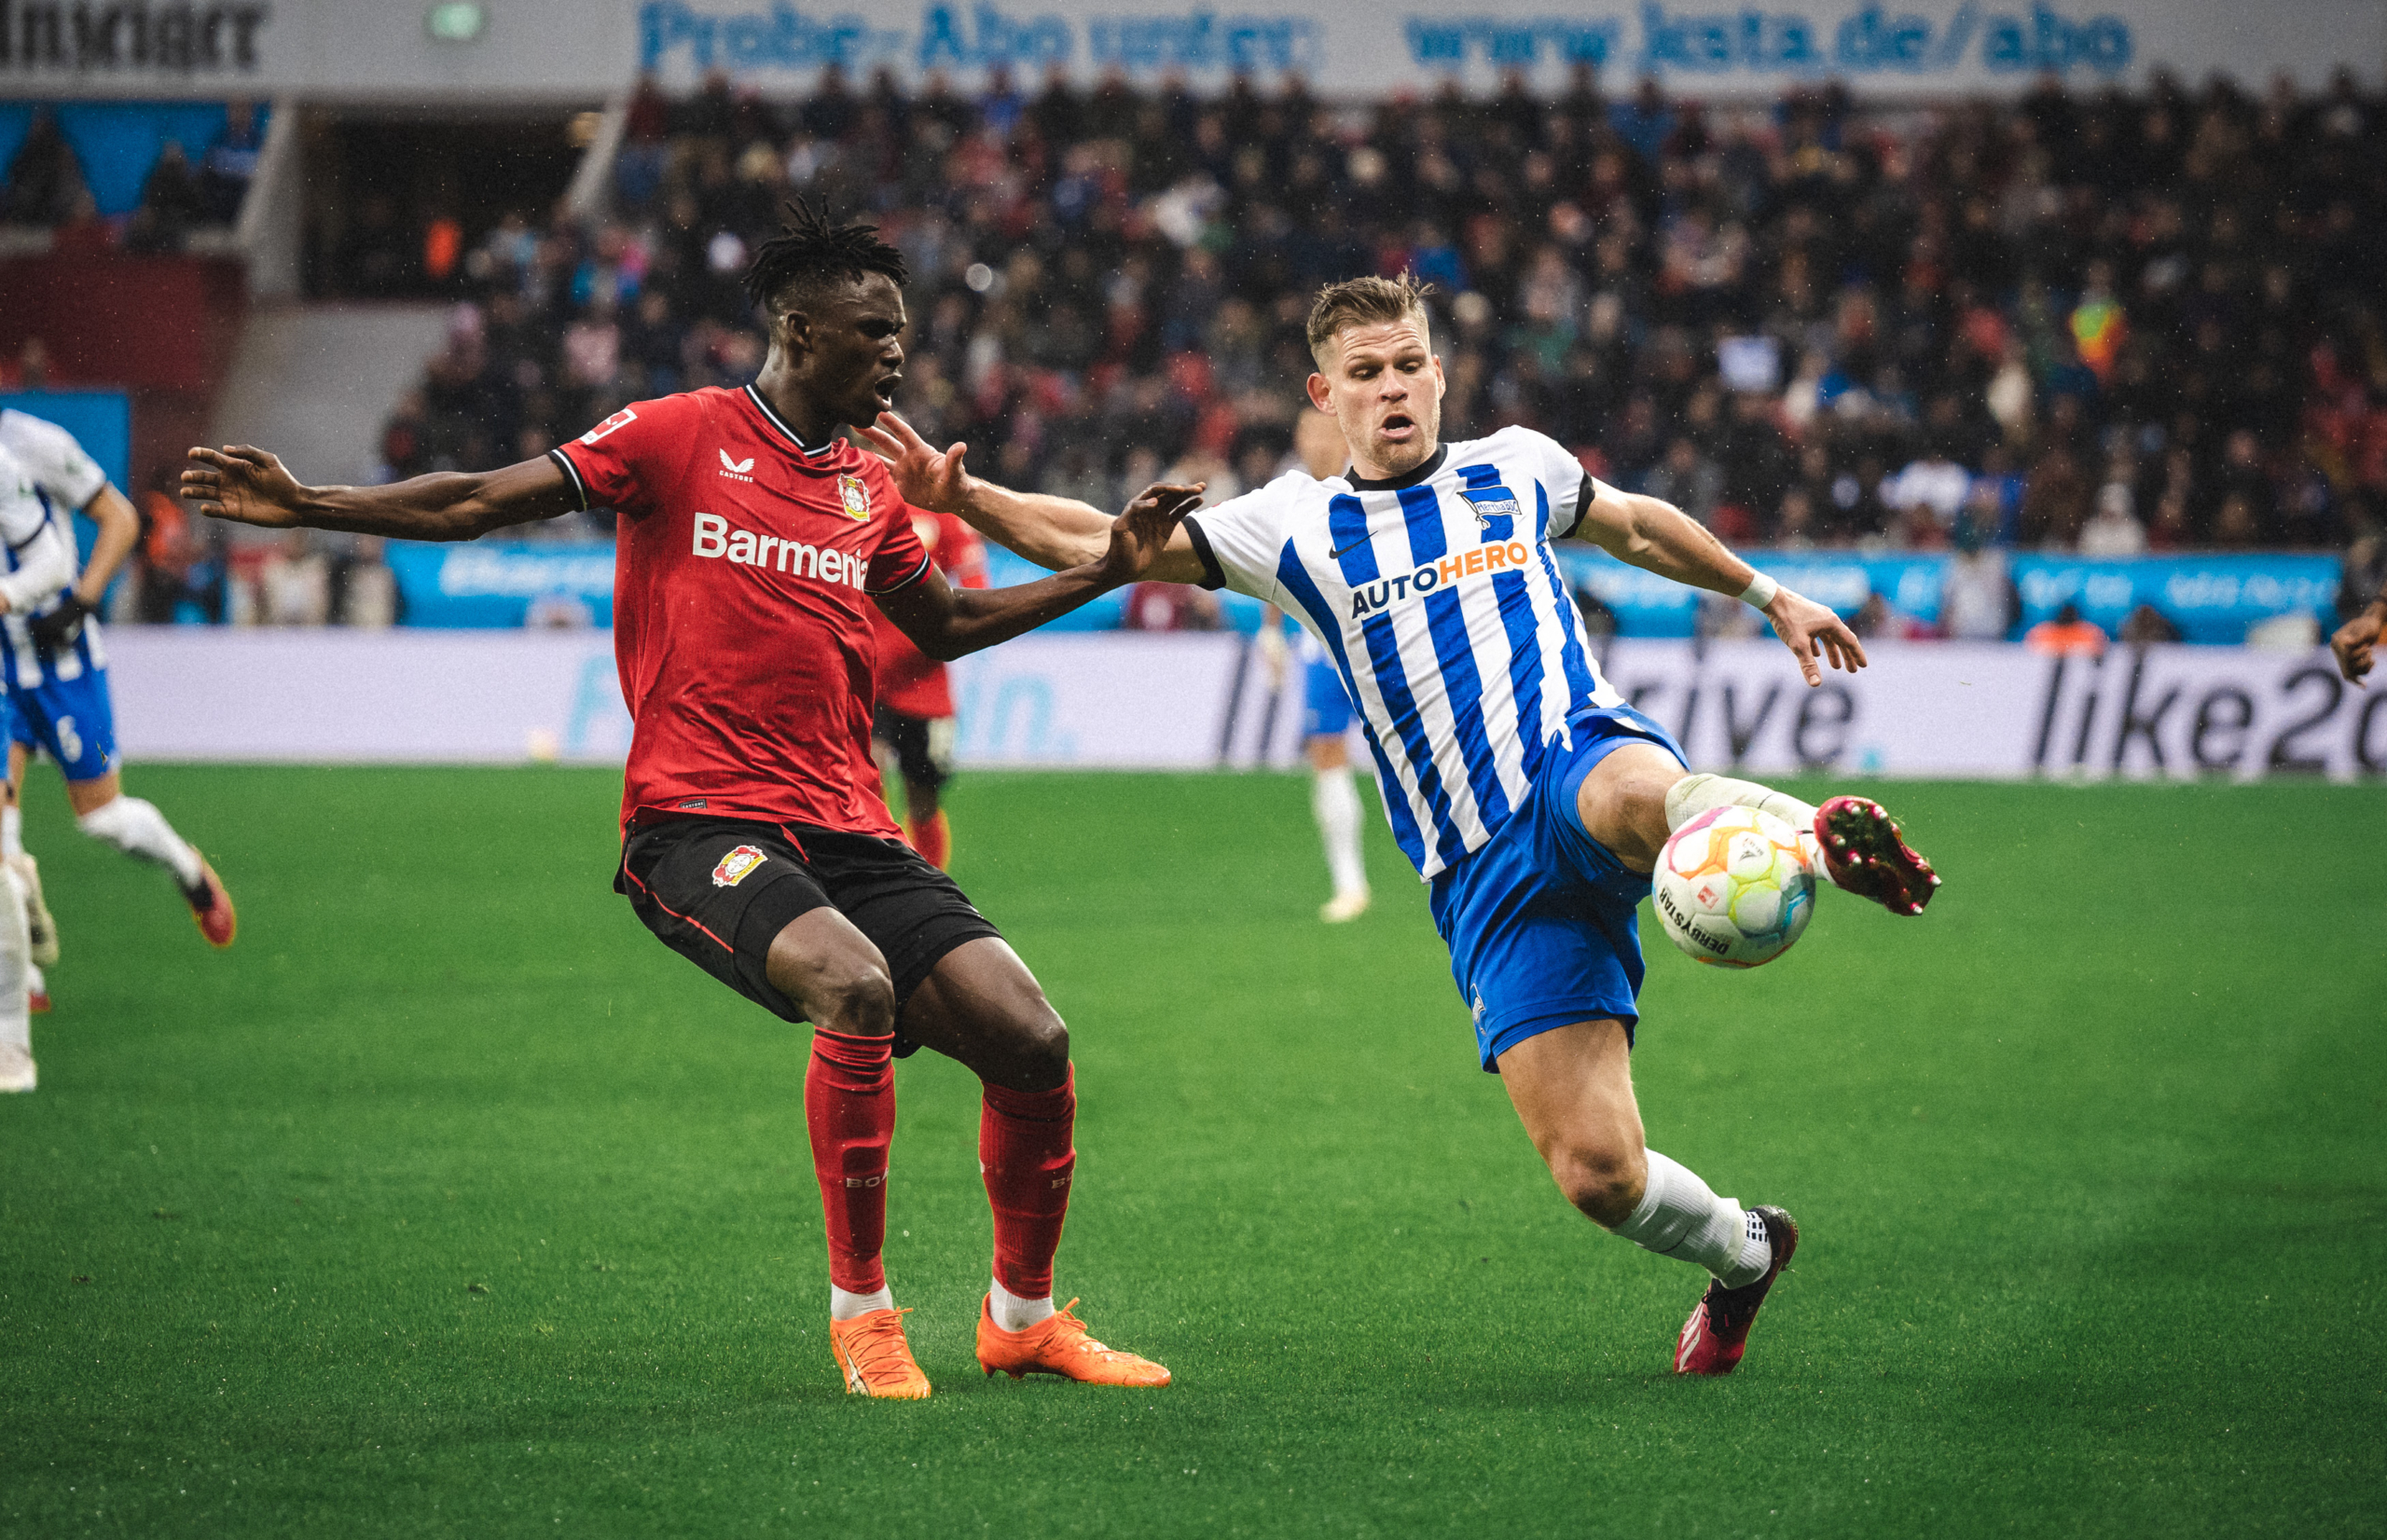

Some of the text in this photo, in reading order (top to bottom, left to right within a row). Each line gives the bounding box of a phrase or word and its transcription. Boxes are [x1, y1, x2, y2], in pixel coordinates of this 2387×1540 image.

[719, 470, 753, 483] CASTORE
[1351, 542, 1528, 620] AUTOHERO
[1659, 887, 1731, 956] DERBYSTAR
